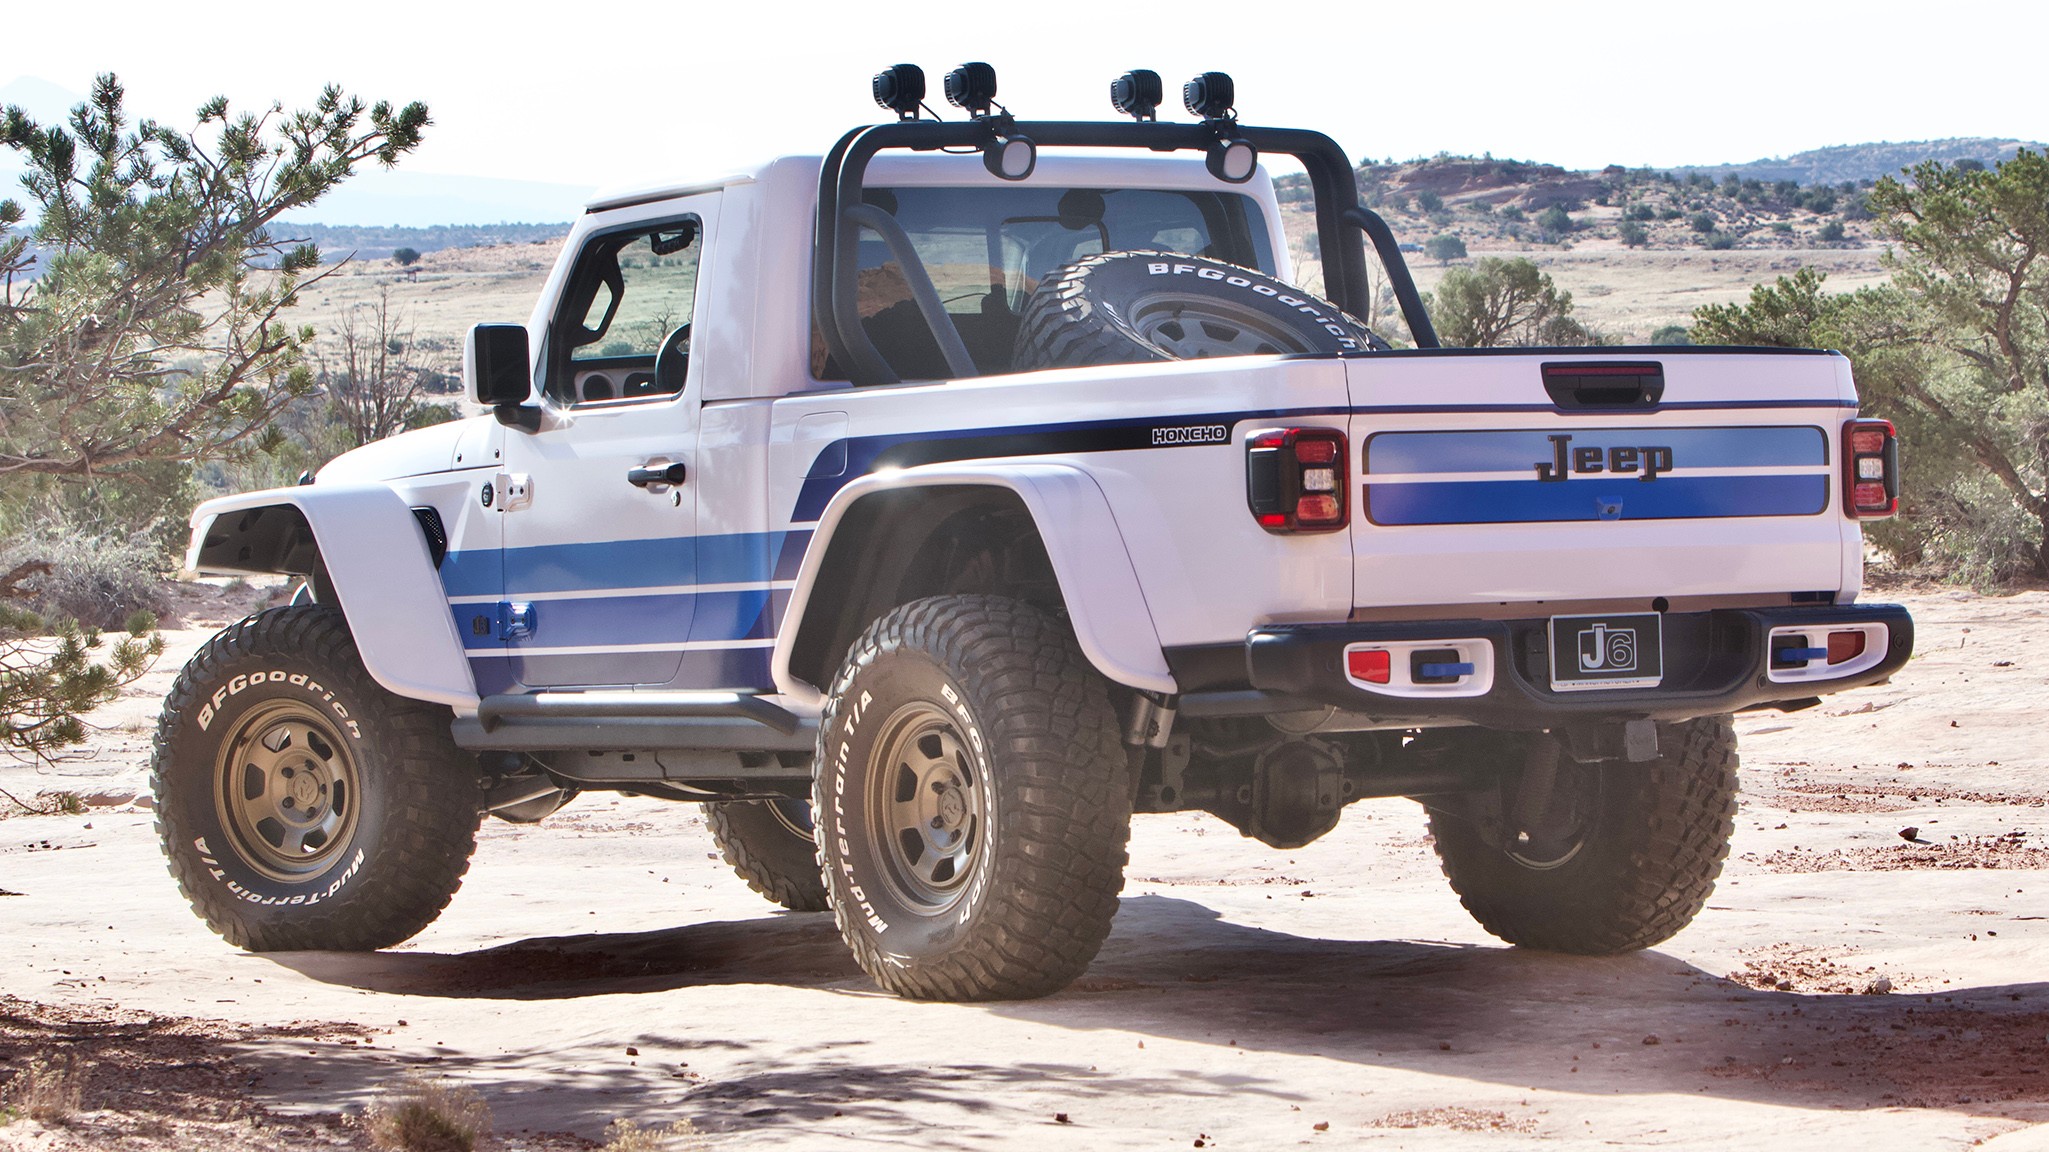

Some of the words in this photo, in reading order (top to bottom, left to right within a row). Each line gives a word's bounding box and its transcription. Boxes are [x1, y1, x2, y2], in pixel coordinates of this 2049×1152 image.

[1147, 262, 1356, 349] BFGoodrich
[1152, 425, 1227, 445] HONCHO
[1534, 434, 1673, 482] Jeep
[1582, 627, 1633, 668] J6
[197, 670, 363, 739] BFGoodrich
[844, 689, 873, 736] T/A
[941, 683, 993, 926] BFGoodrich
[194, 837, 226, 882] T/A
[834, 741, 889, 935] Mud-Terrain
[226, 848, 366, 907] Mud-Terrain
